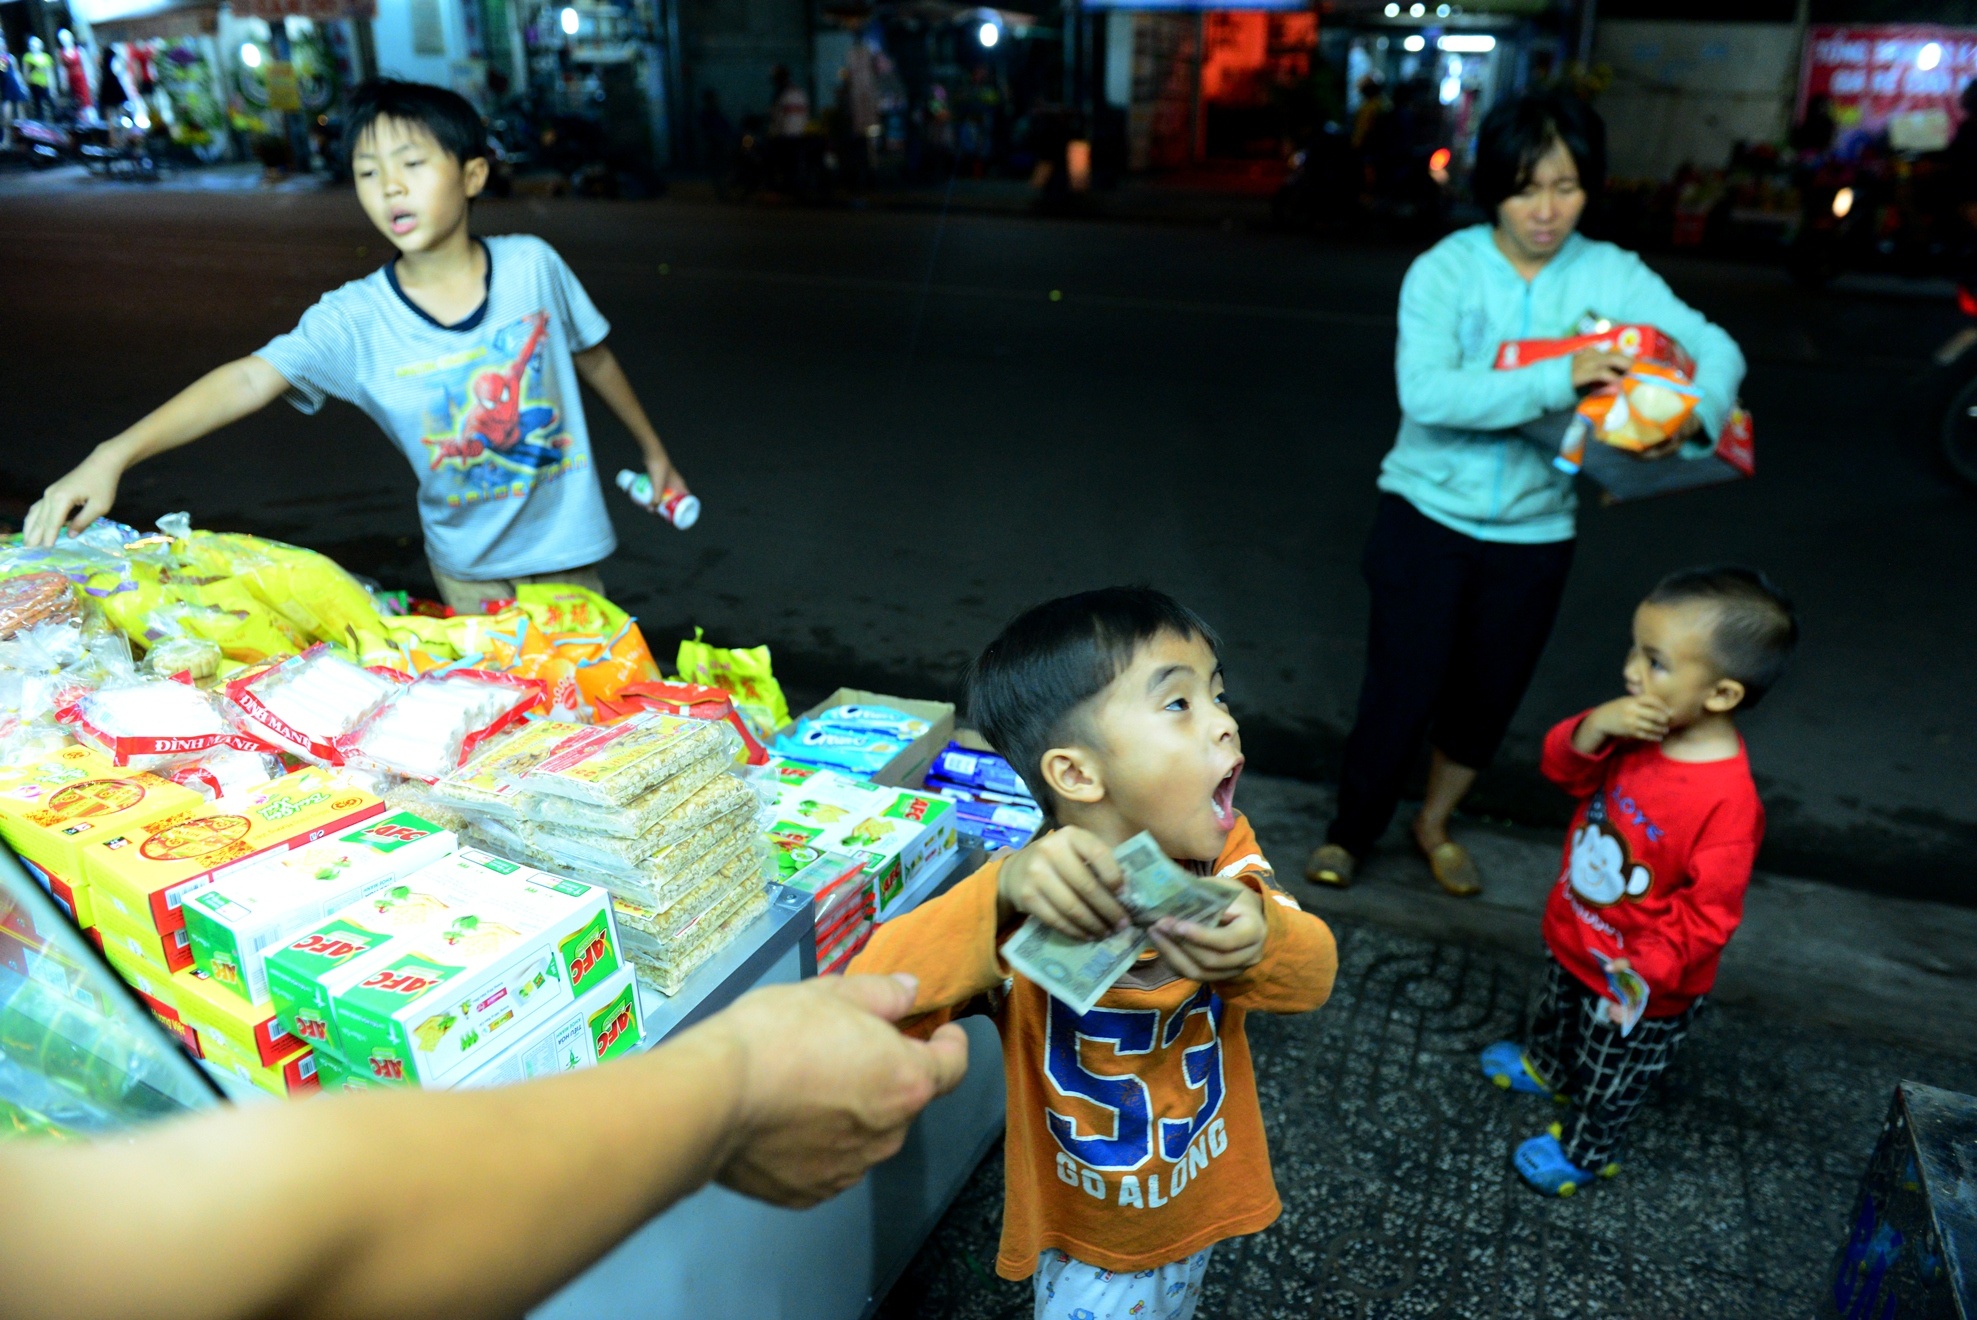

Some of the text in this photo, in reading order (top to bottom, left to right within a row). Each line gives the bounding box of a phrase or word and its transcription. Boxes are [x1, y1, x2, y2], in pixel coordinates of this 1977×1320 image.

[904, 797, 931, 822] AFC
[363, 823, 430, 842] AFC
[289, 934, 370, 958] AFC
[570, 928, 608, 987] AFC
[359, 970, 441, 994] AFC
[295, 1016, 327, 1041] AFC
[596, 1001, 634, 1059] AFC
[368, 1056, 403, 1081] AFC
[1056, 1117, 1229, 1210] GO ALONG
